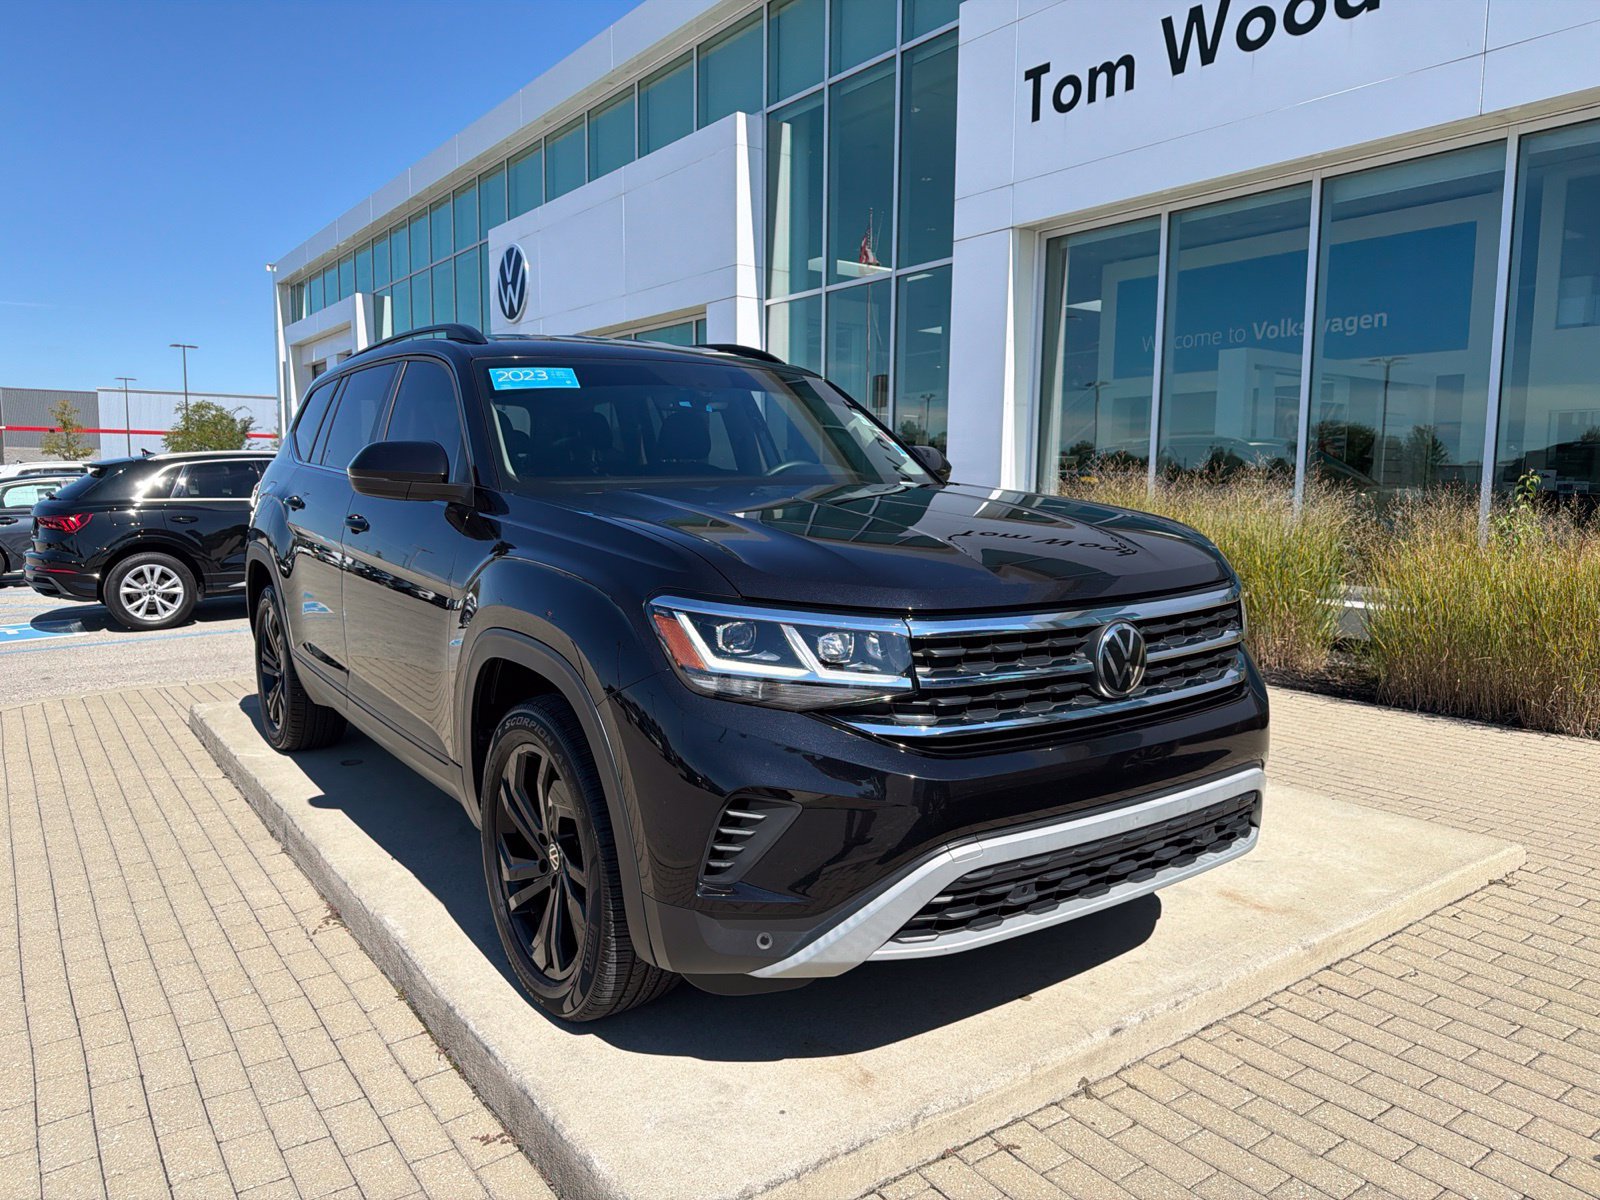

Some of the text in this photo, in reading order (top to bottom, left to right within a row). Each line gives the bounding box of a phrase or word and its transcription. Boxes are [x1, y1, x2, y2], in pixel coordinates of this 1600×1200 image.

[1024, 0, 1380, 123] Tom Woo
[1142, 330, 1223, 353] Wcome
[1229, 327, 1247, 343] to
[495, 369, 549, 382] 2023
[504, 716, 554, 747] SCORPION
